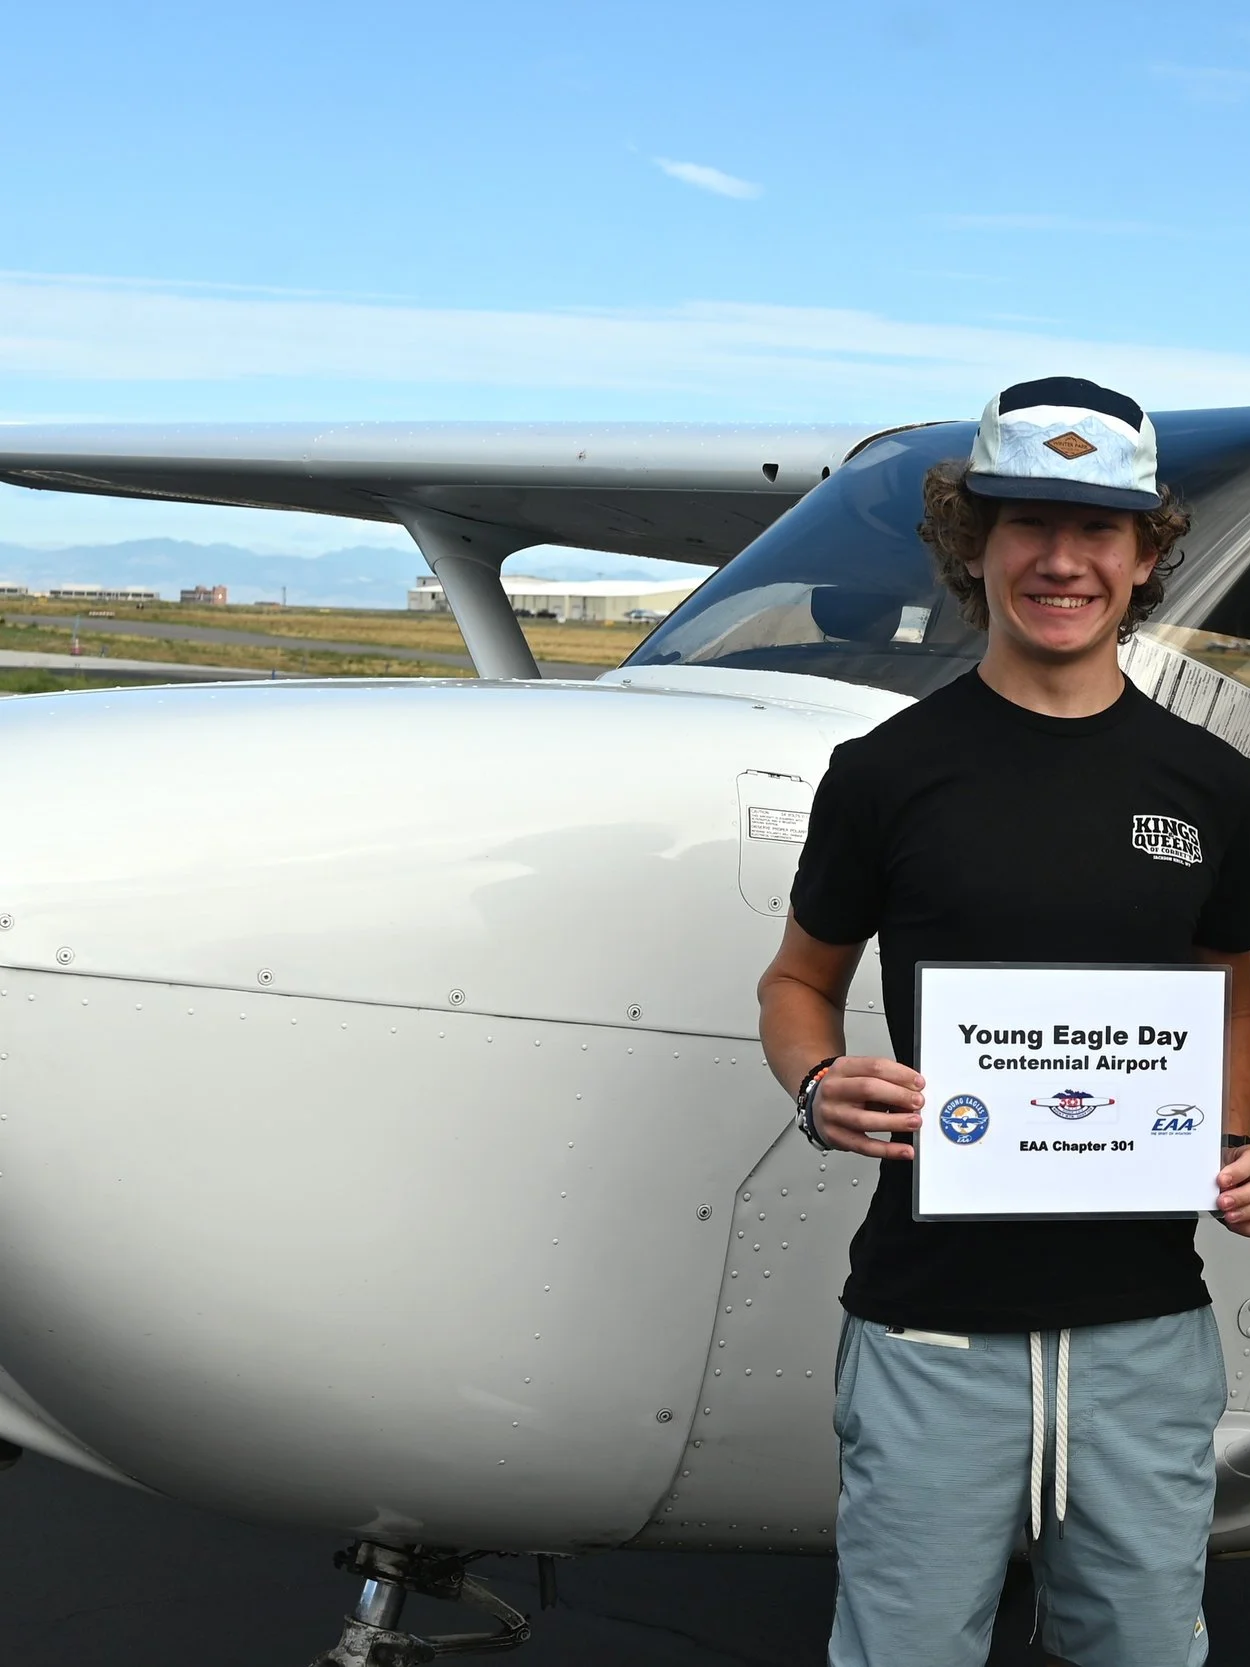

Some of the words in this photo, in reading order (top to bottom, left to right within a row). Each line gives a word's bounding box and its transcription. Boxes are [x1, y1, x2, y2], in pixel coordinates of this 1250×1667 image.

[1135, 817, 1199, 847] KINGS
[1135, 834, 1201, 861] QUEENS
[958, 1024, 1043, 1050] Young
[1053, 1025, 1129, 1050] Eagle
[1138, 1025, 1188, 1051] Day
[978, 1054, 1089, 1070] Centennial
[1096, 1055, 1168, 1074] Airport
[945, 1097, 964, 1114] YOUNG
[1151, 1118, 1194, 1131] EAA
[1020, 1141, 1048, 1151] EAA
[1052, 1141, 1107, 1153] Chapter
[1111, 1140, 1135, 1151] 301
